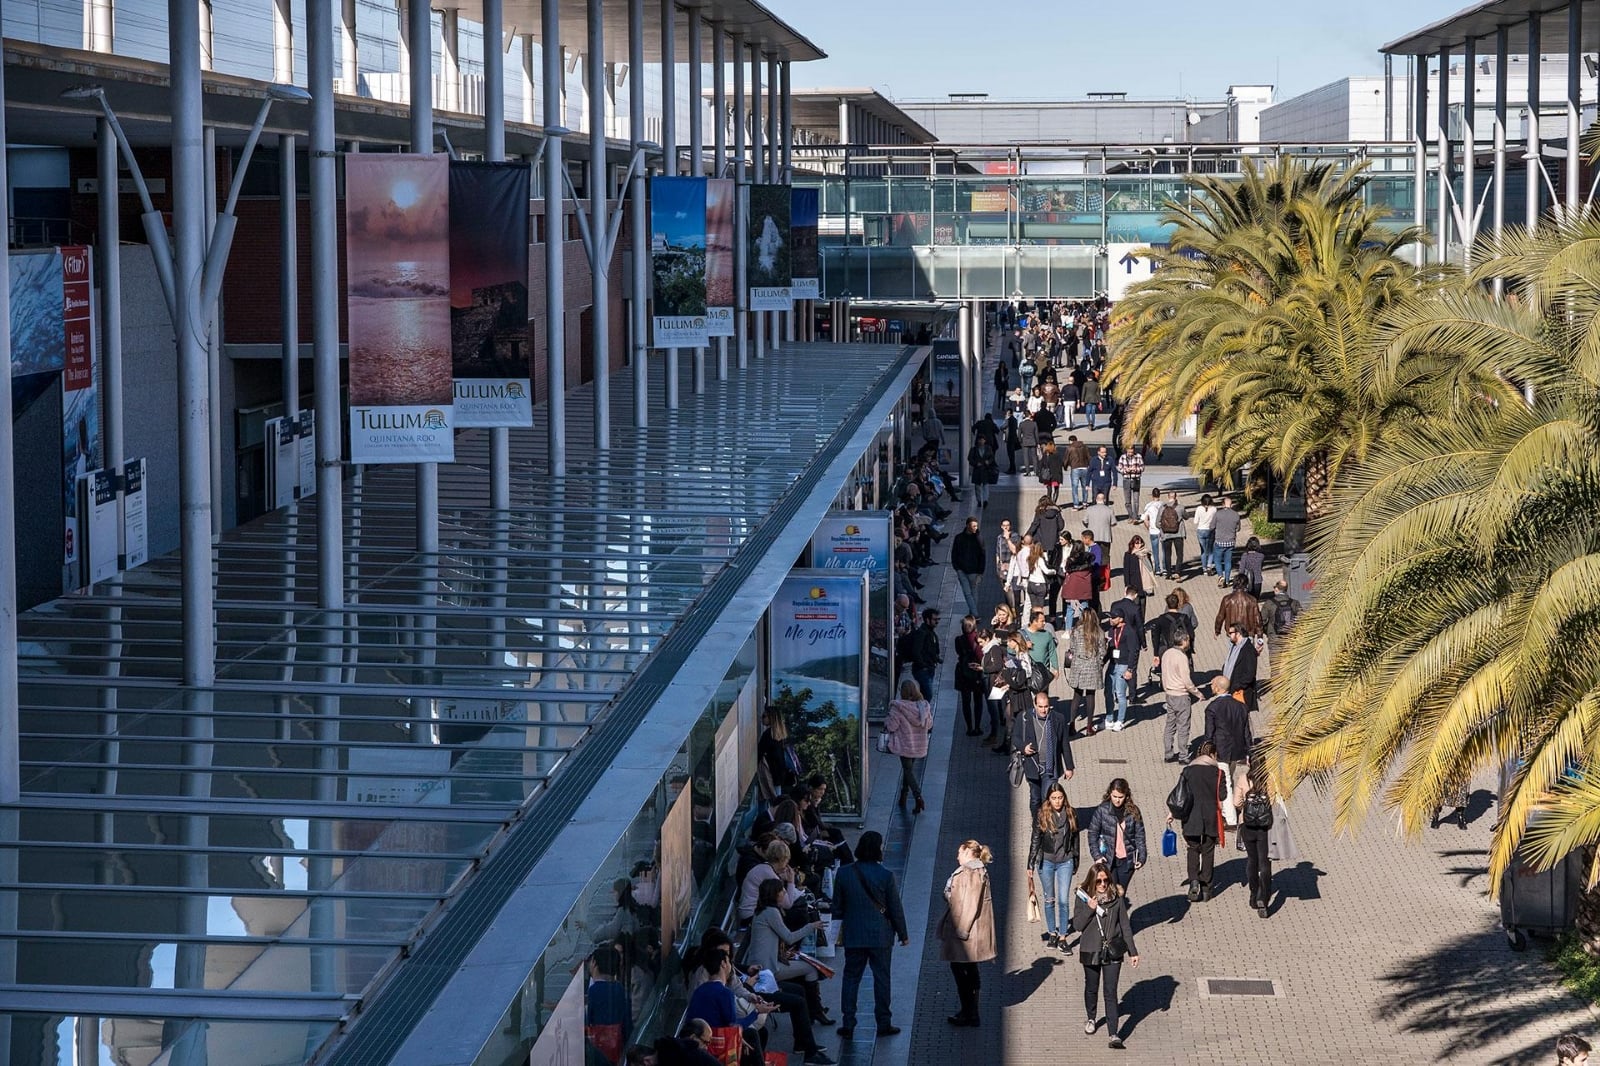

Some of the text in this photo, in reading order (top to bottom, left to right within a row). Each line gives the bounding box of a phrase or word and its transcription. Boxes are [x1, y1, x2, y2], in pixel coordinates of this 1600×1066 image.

[656, 317, 692, 330] TULUM
[453, 381, 504, 399] TULUM
[356, 409, 422, 430] TULUM
[369, 434, 436, 443] QUINTANA ROO
[784, 622, 847, 646] Me gusta
